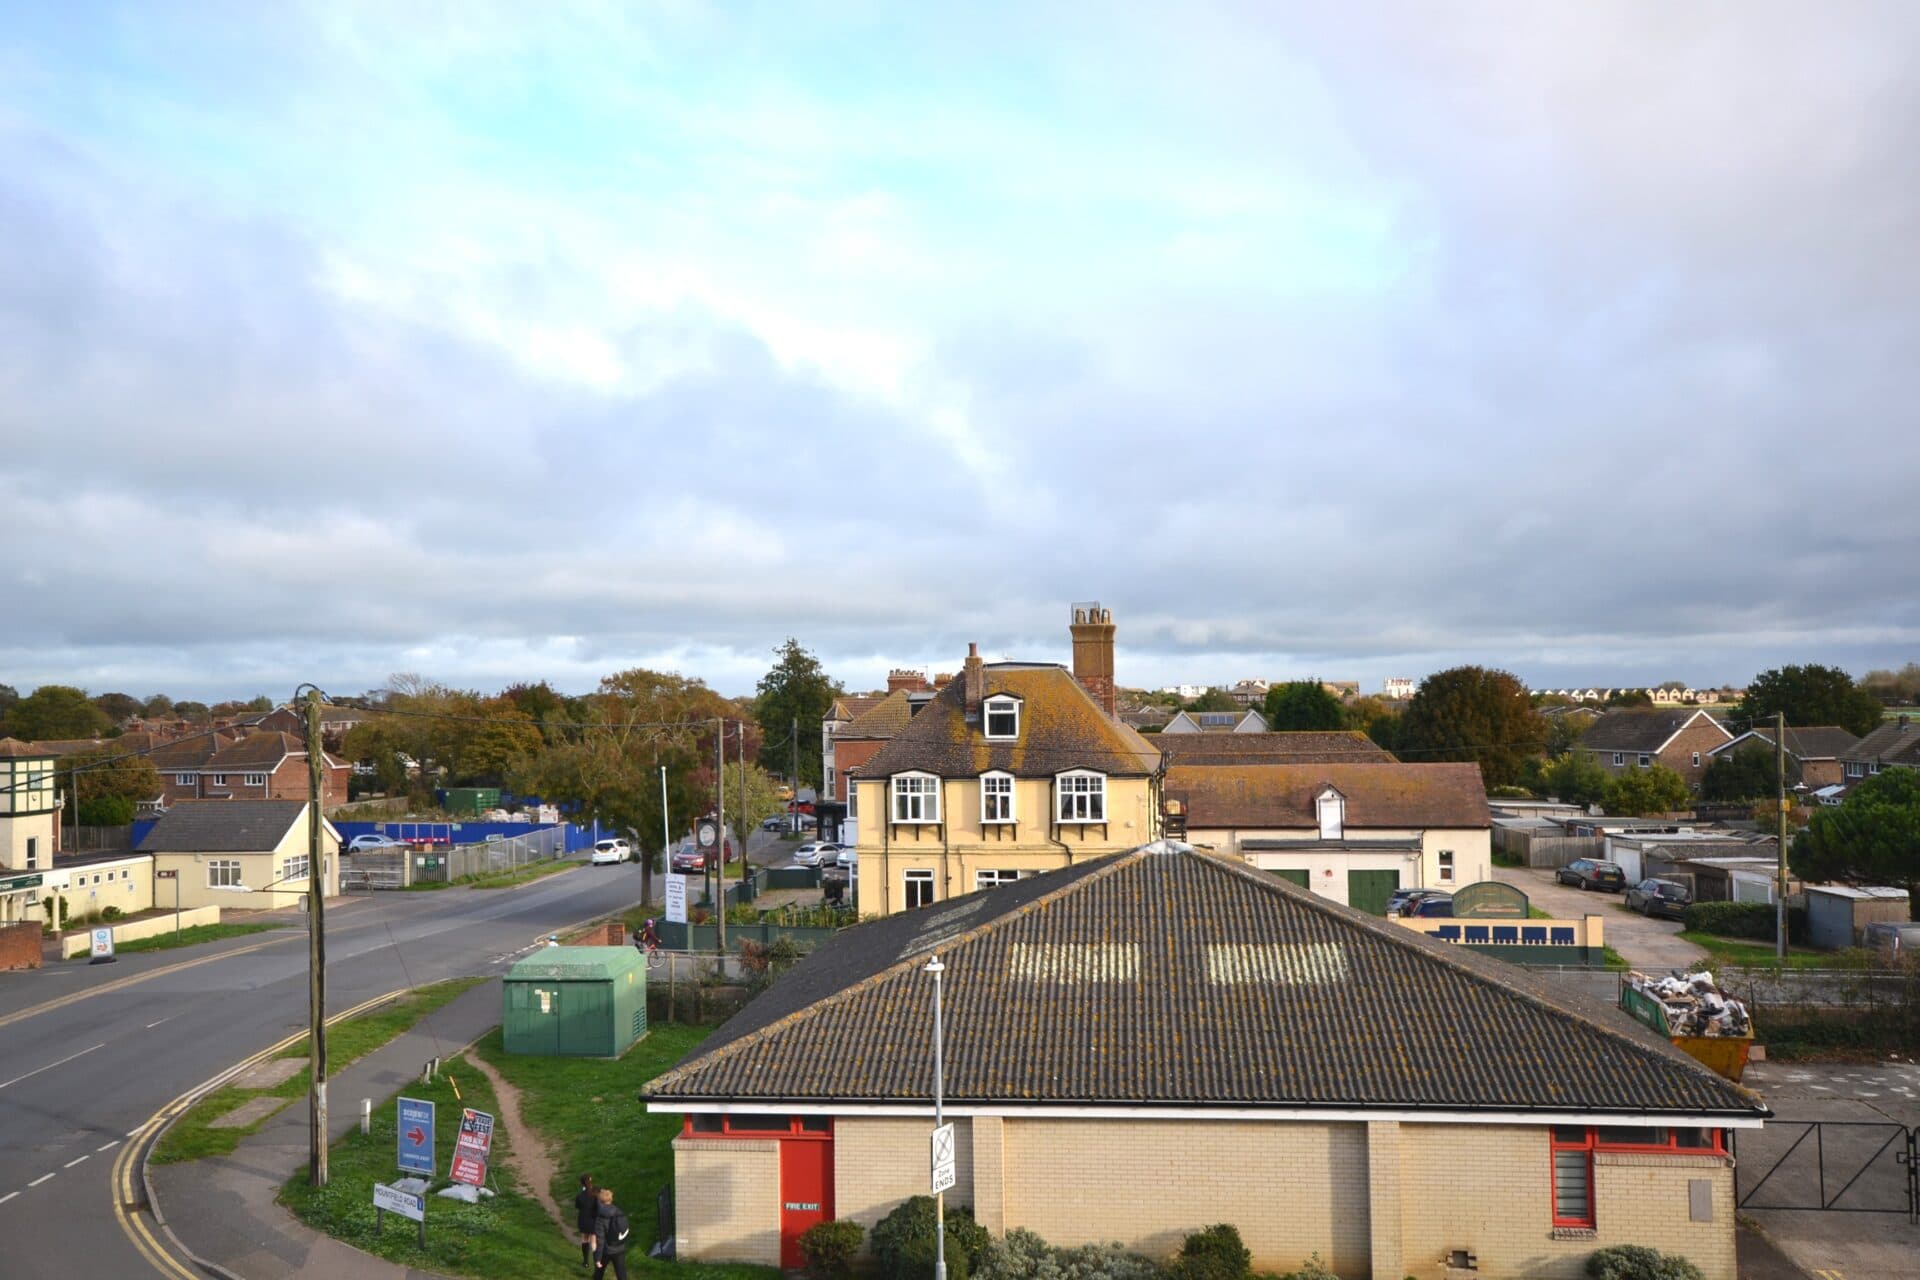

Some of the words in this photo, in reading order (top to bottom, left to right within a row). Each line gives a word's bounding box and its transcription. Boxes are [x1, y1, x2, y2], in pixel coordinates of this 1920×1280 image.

[938, 1168, 950, 1178] Zone
[935, 1174, 954, 1190] ENDS
[404, 1196, 417, 1208] ROAD
[785, 1202, 800, 1210] FIRE
[802, 1203, 818, 1211] EXIT
